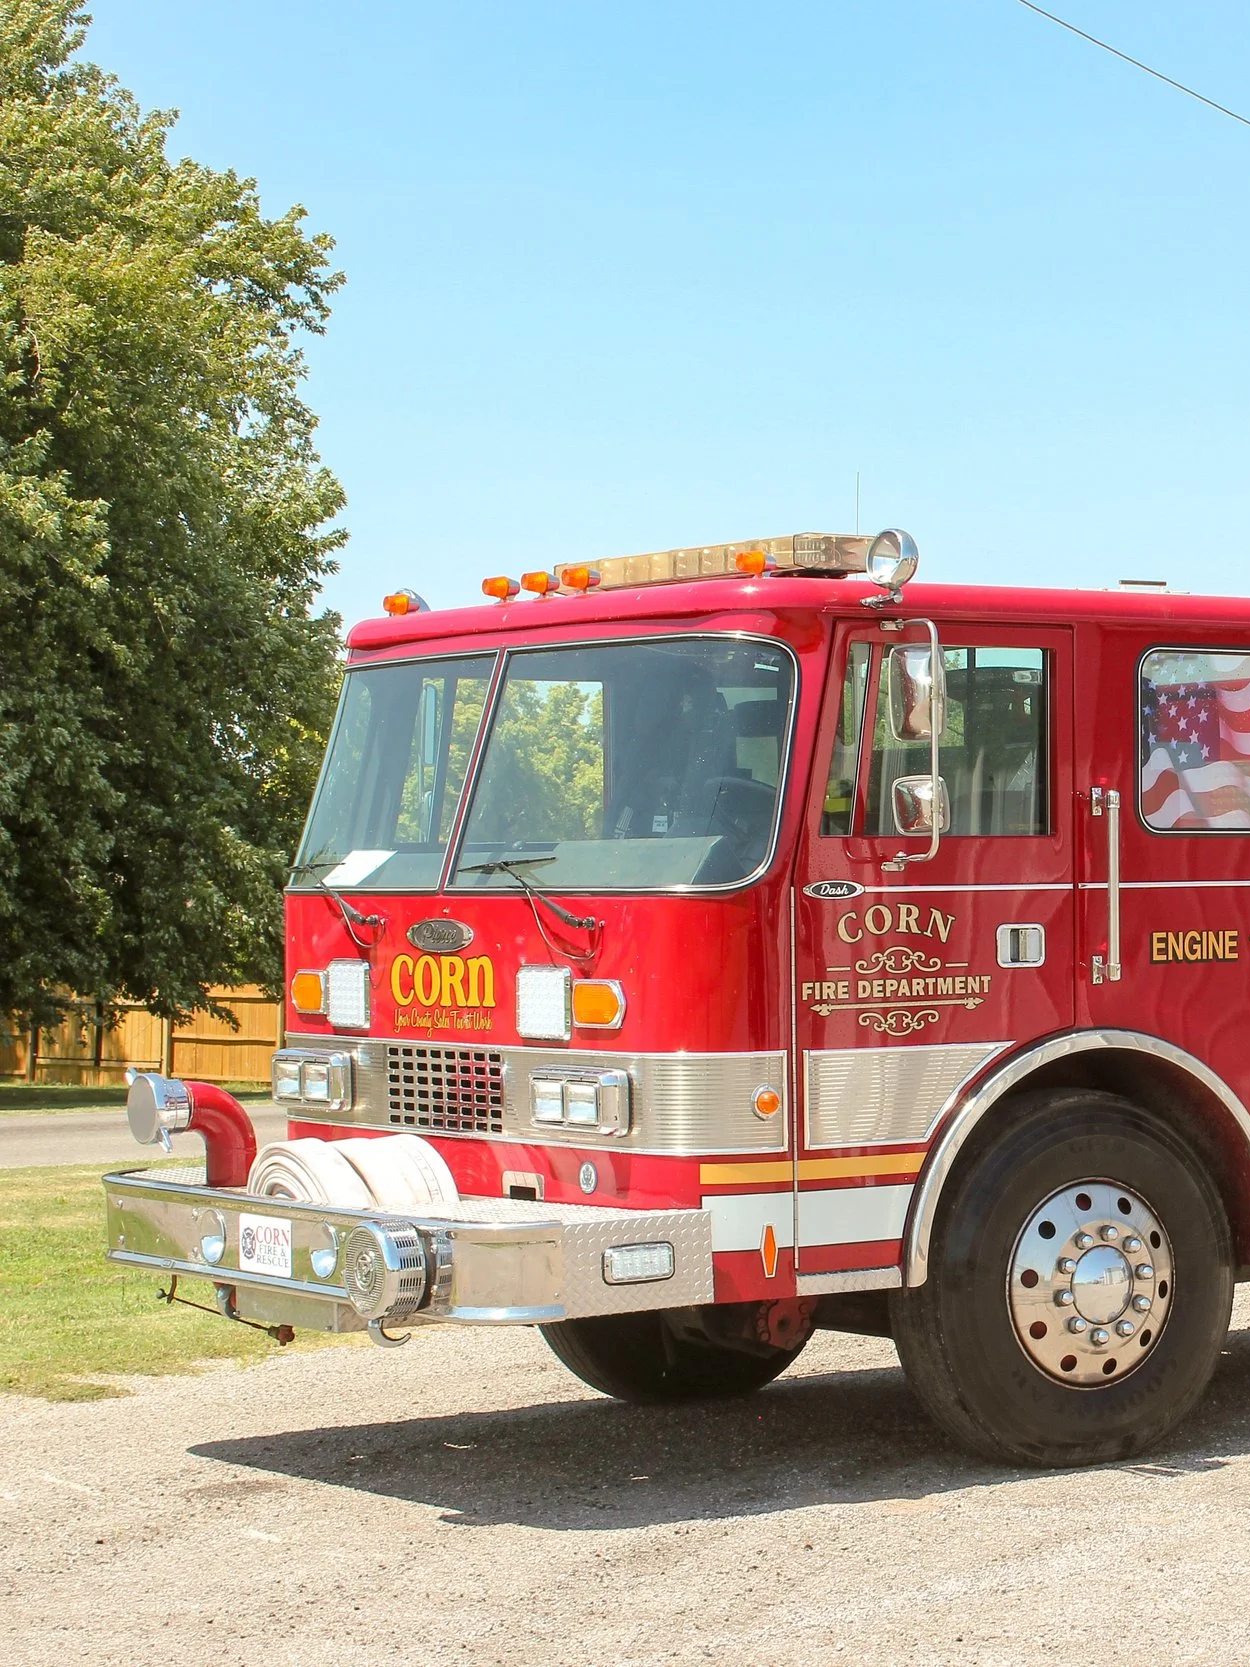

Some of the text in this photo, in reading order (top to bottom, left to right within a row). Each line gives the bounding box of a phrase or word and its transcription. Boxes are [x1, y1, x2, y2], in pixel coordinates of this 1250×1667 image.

[819, 884, 850, 896] Dash
[836, 903, 956, 944] CORN
[1150, 929, 1239, 964] ENGINE
[801, 975, 993, 1001] FIRE DEPARTMENT
[255, 1225, 290, 1247] CORN
[256, 1253, 290, 1268] RESCUE
[259, 1244, 279, 1256] FIRE
